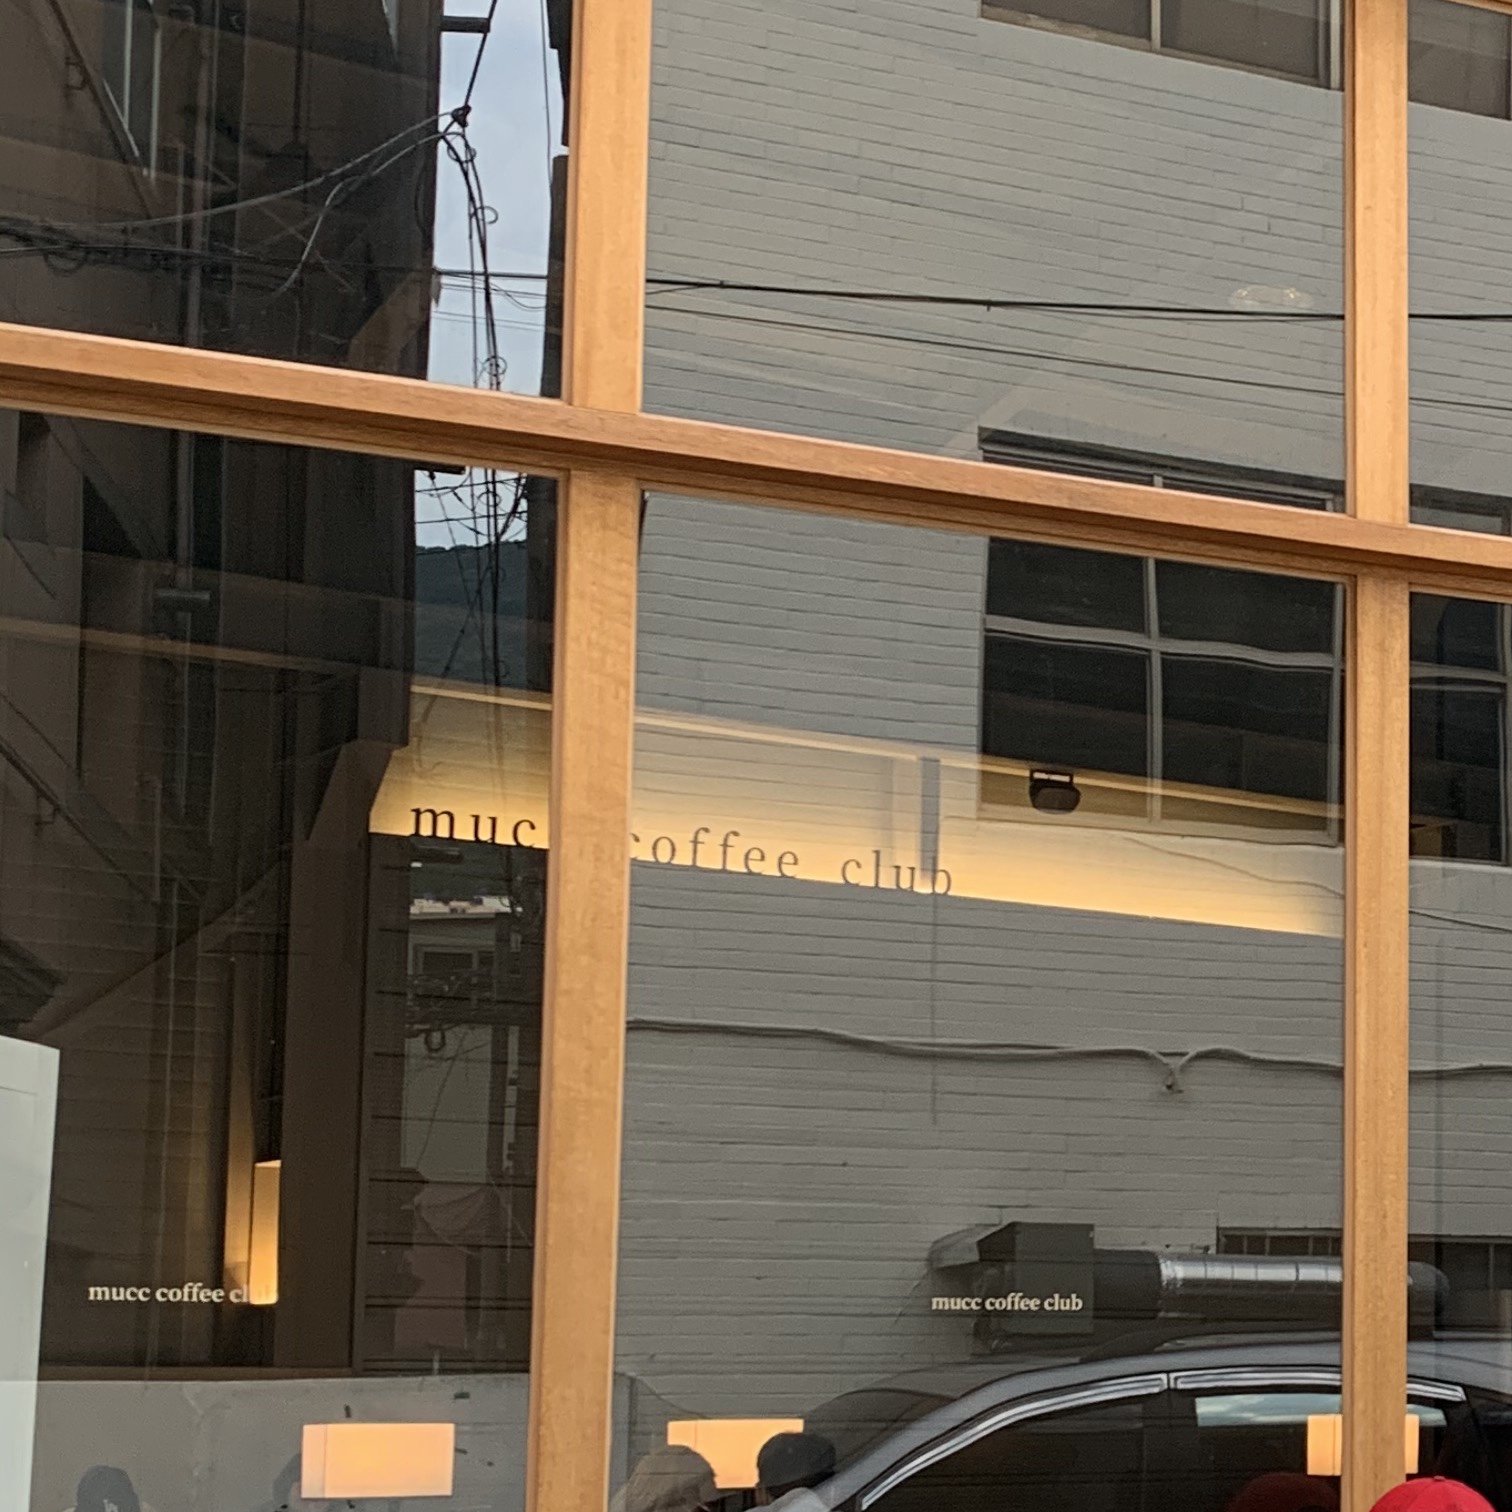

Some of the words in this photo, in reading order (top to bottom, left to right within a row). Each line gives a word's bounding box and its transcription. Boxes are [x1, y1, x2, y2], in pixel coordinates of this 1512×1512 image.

[410, 806, 537, 849] muc
[840, 849, 952, 896] club
[88, 1285, 150, 1301] mucc
[155, 1282, 225, 1302] coffee
[229, 1284, 278, 1303] cl
[931, 1296, 982, 1311] mucc
[984, 1292, 1041, 1311] coffee
[1043, 1293, 1083, 1311] club
